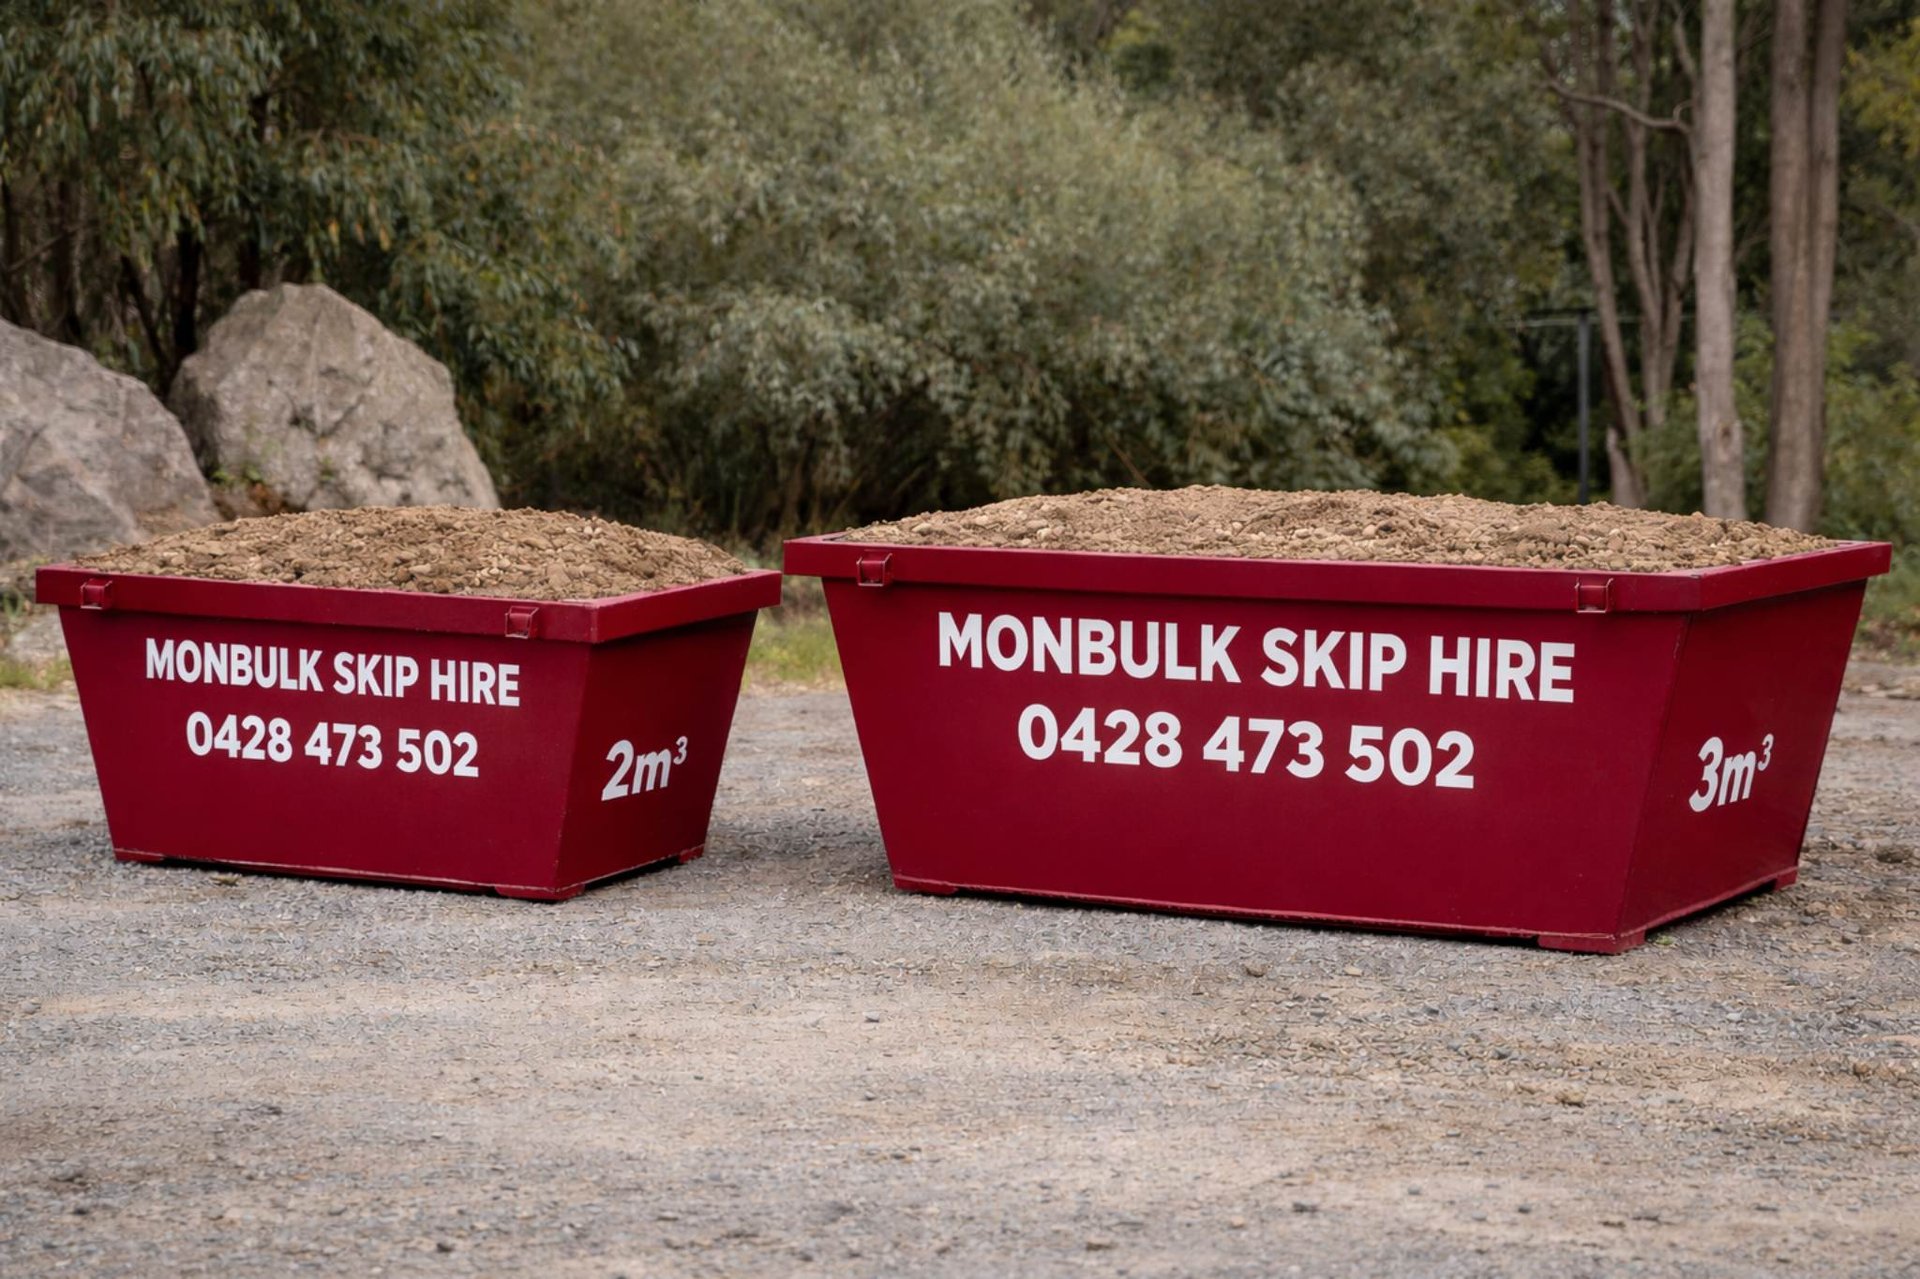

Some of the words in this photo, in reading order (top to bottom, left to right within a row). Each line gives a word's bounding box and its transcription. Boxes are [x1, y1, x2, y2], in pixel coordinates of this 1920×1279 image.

[146, 637, 324, 692] MONBULK
[333, 651, 419, 698] SKIP
[430, 658, 520, 707] HIRE
[938, 611, 1242, 683] MONBULK
[1260, 627, 1407, 692] SKIP
[1429, 635, 1575, 703] HIRE
[186, 711, 293, 763] 0428
[304, 721, 383, 770] 473
[396, 728, 479, 778] 502
[1017, 703, 1183, 768] 0428
[1202, 715, 1325, 779] 473
[1344, 724, 1475, 789] 502
